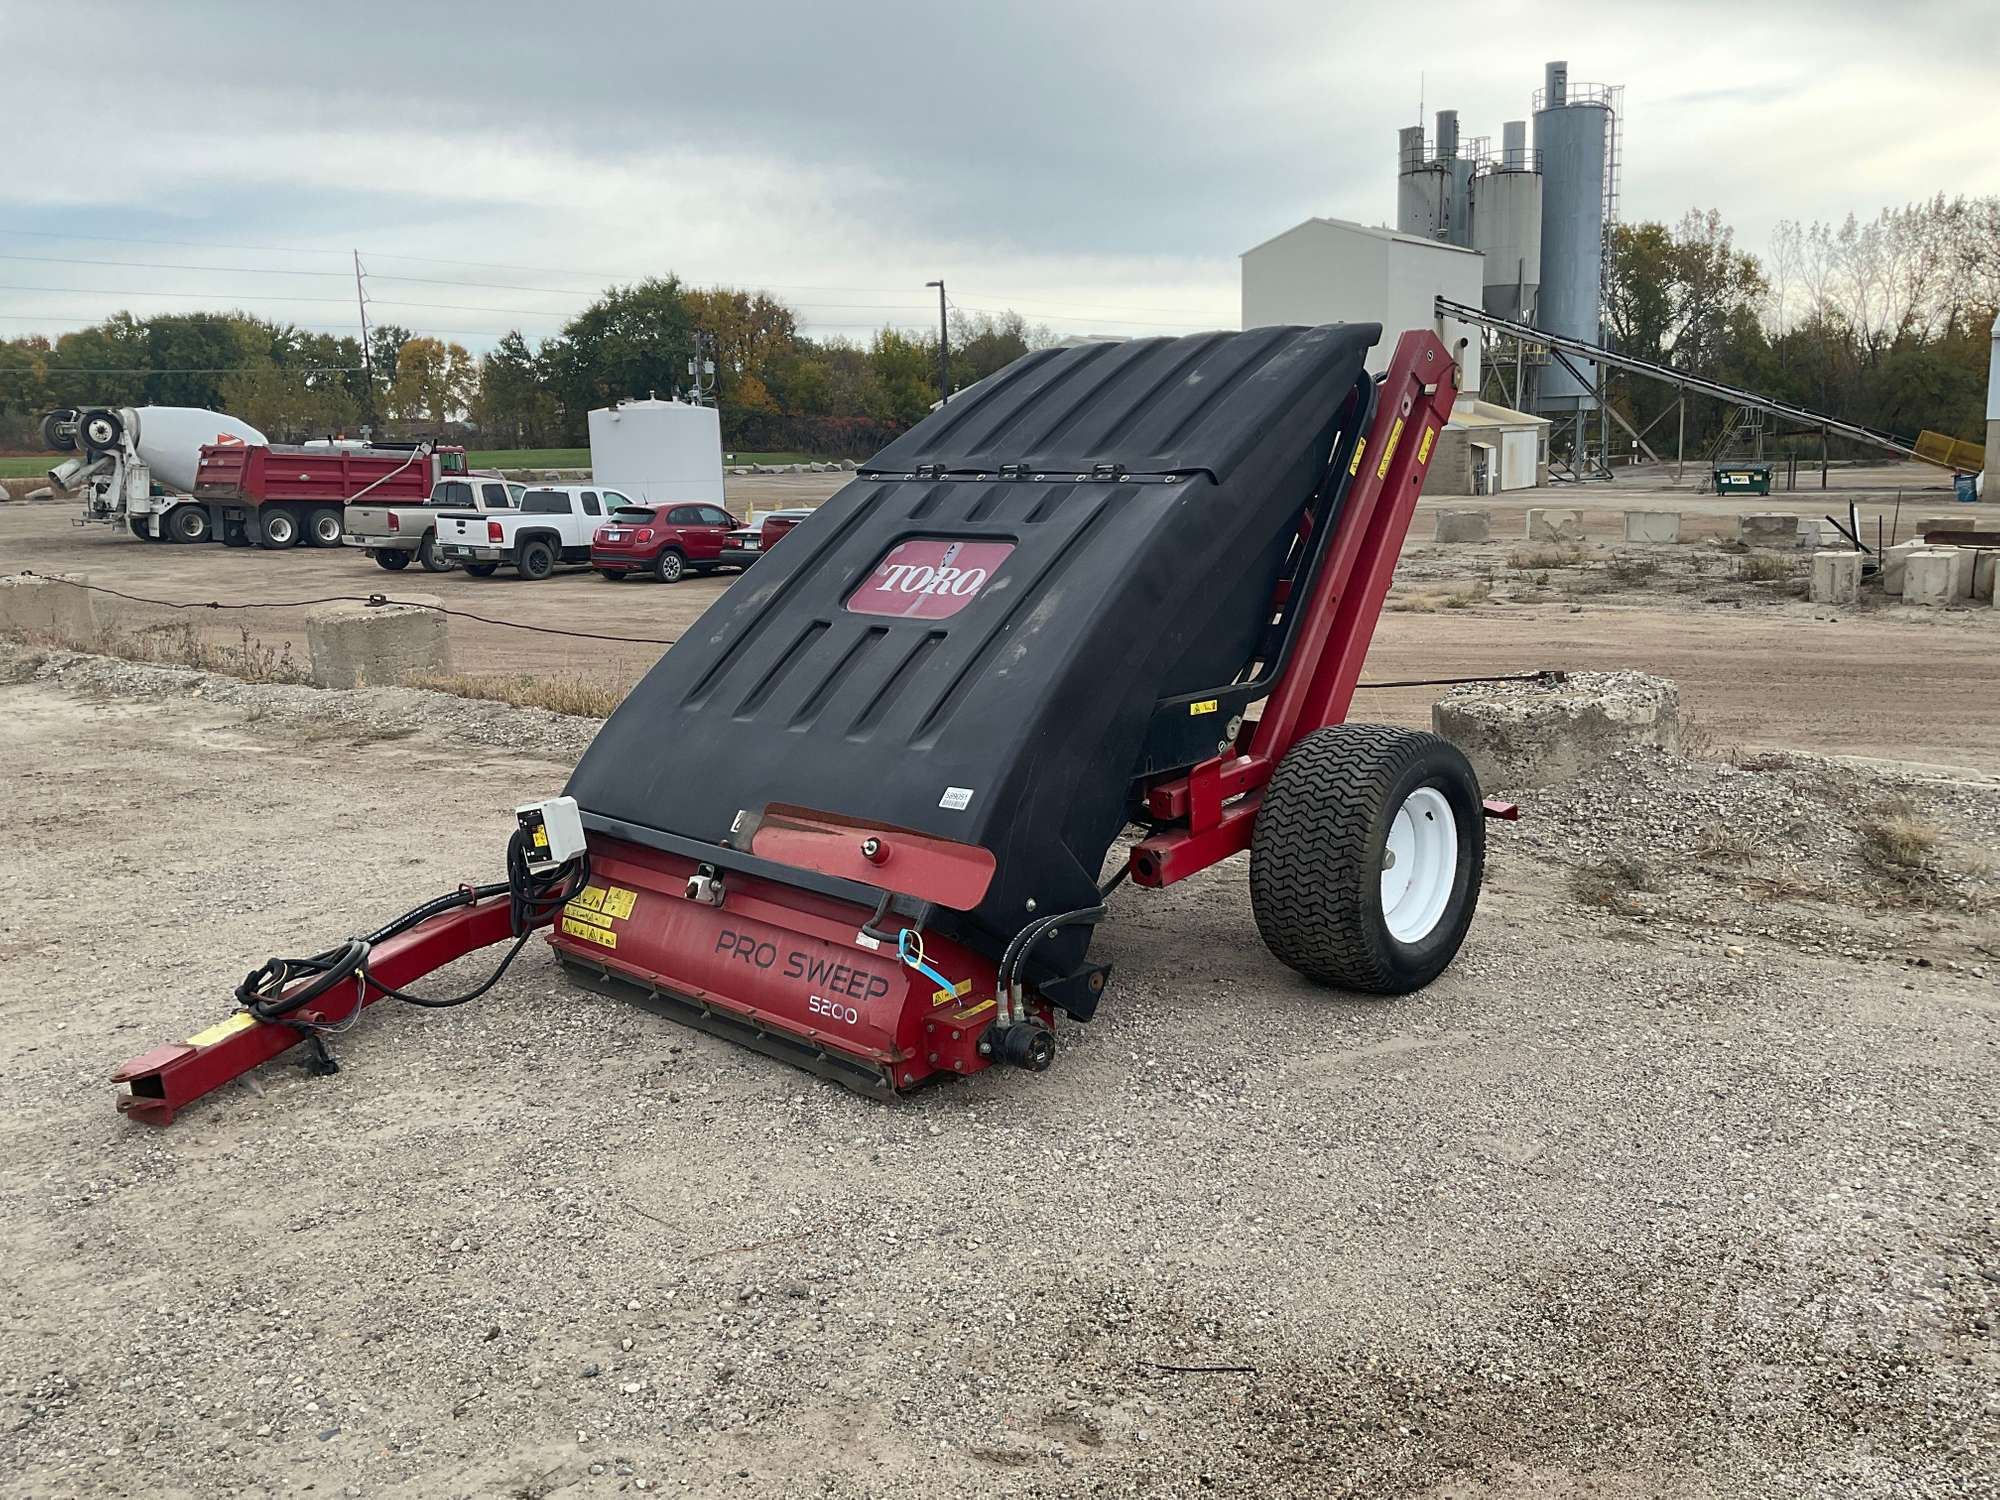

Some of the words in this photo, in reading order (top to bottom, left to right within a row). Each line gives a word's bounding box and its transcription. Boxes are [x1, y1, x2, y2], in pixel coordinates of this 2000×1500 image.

[876, 564, 986, 596] TORO
[714, 930, 776, 969] PRO
[783, 951, 889, 1001] SWEEP
[808, 995, 858, 1025] 5200
